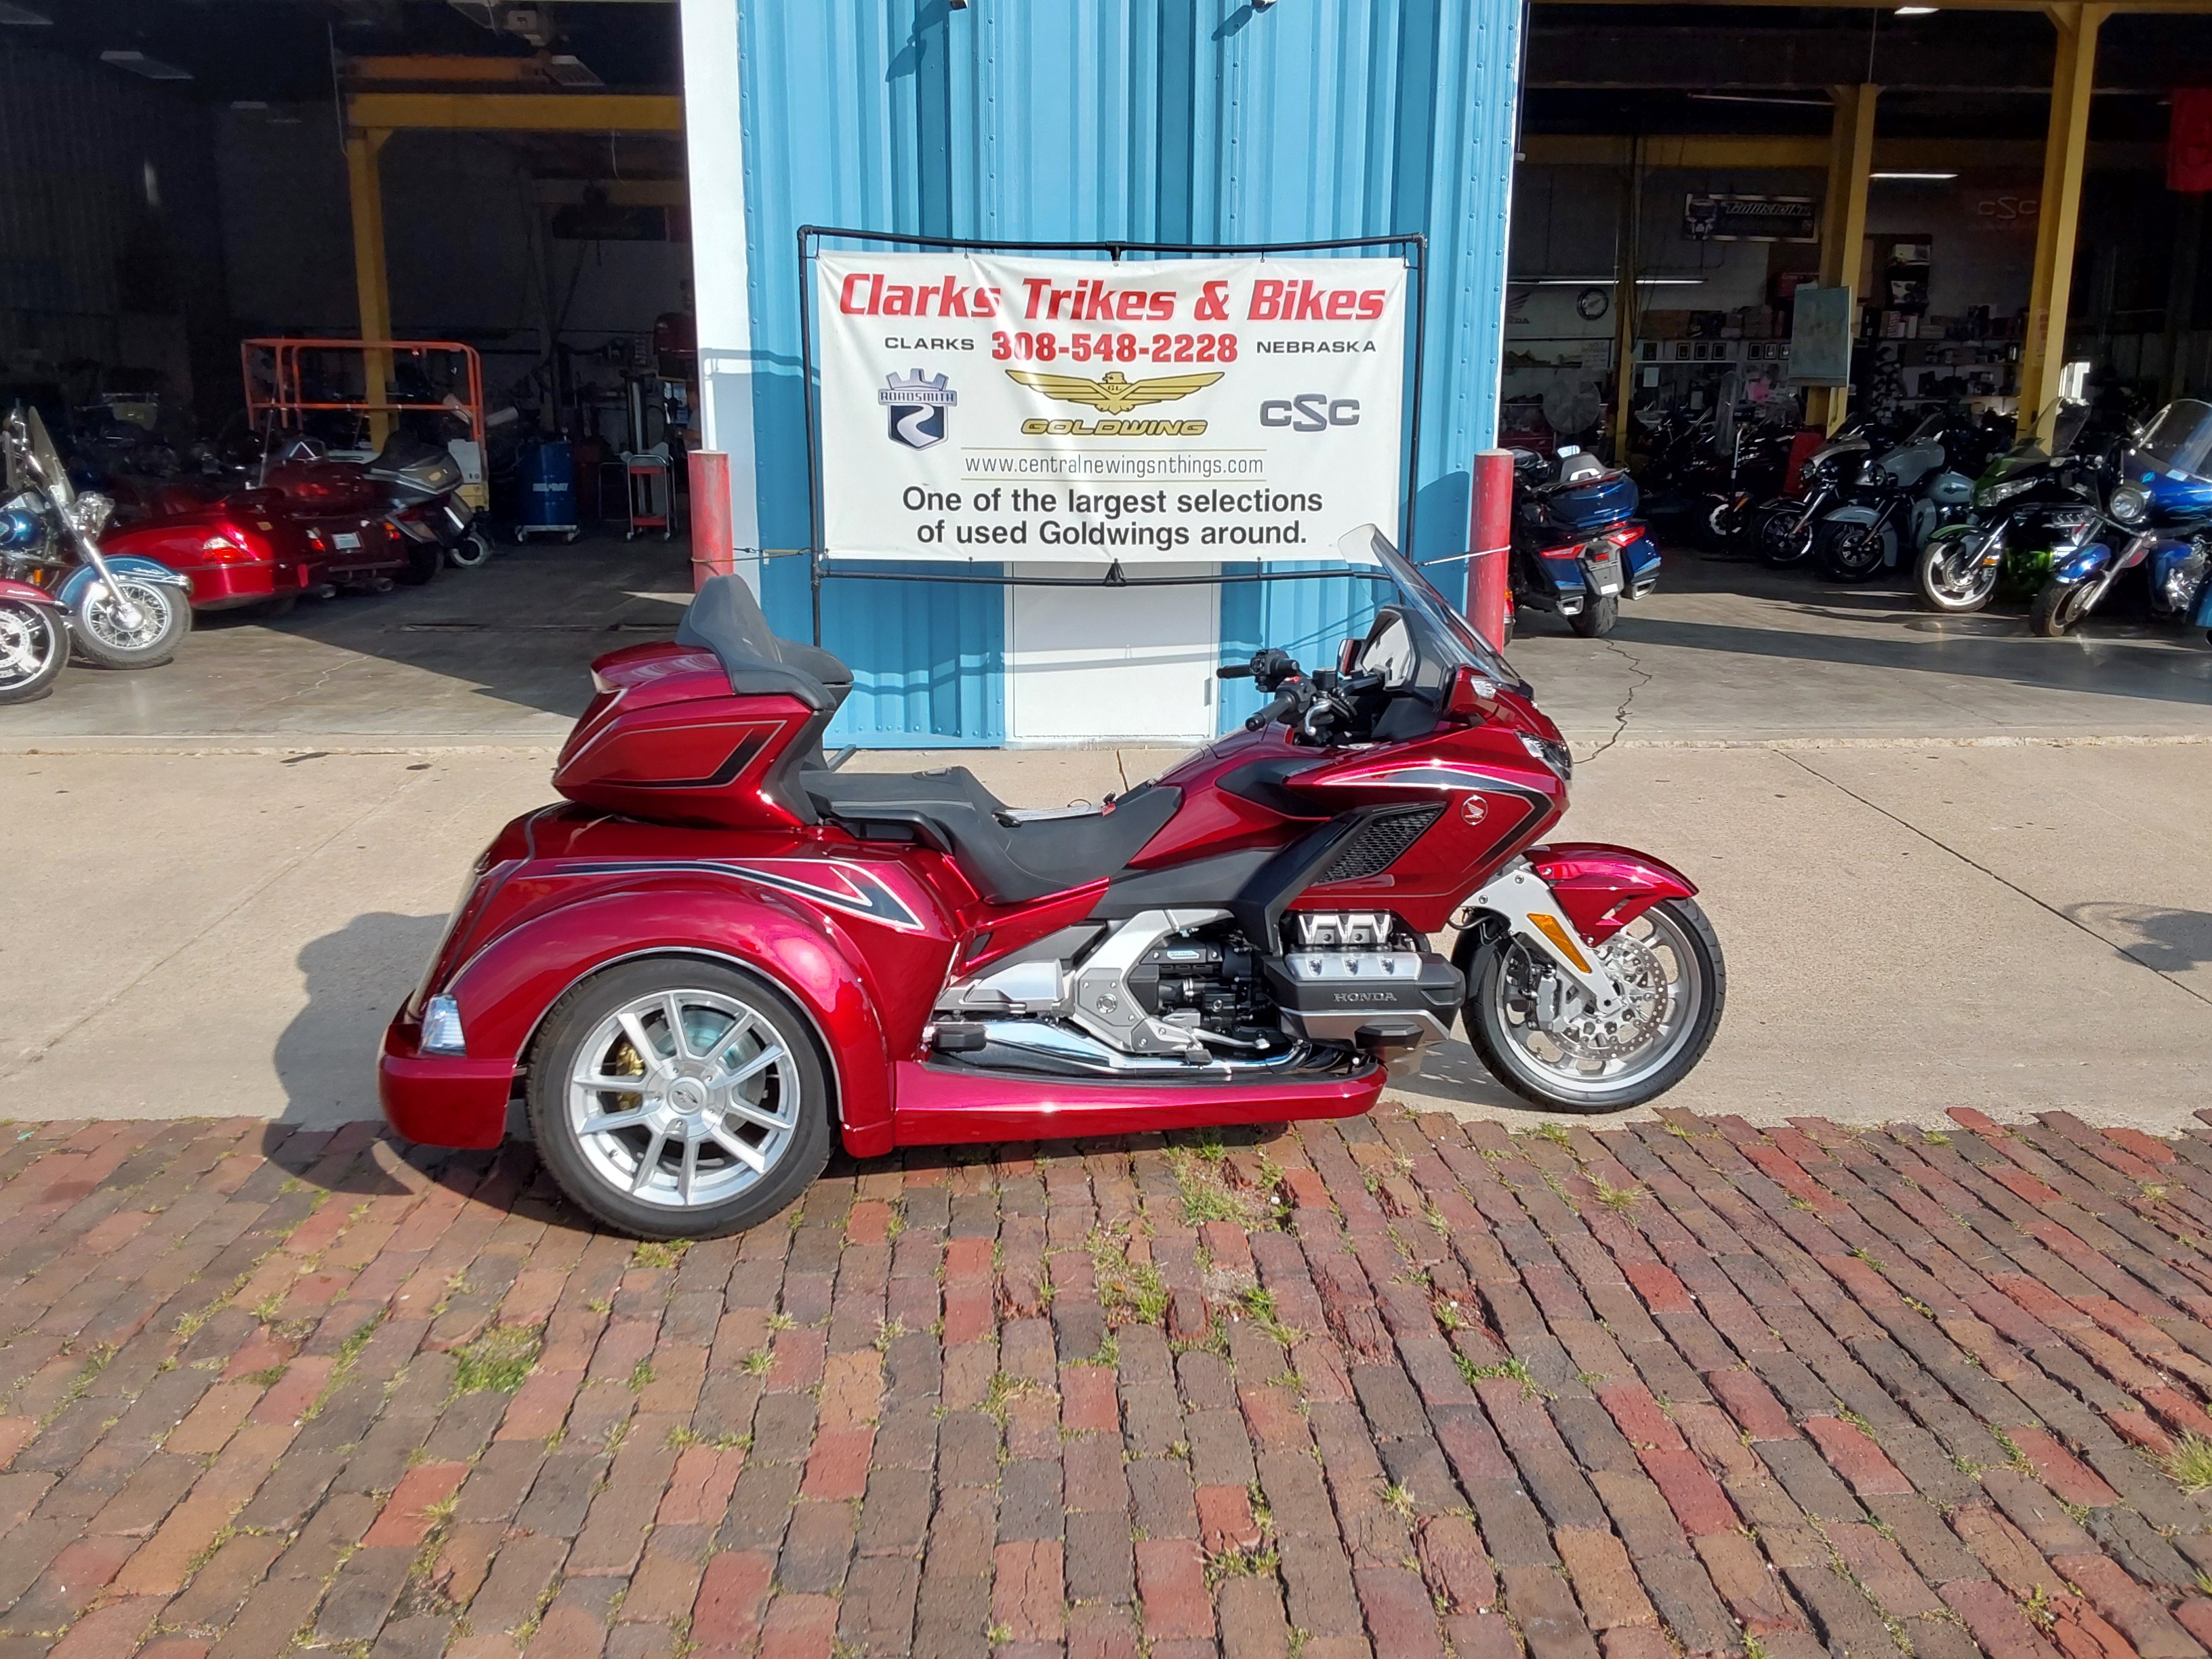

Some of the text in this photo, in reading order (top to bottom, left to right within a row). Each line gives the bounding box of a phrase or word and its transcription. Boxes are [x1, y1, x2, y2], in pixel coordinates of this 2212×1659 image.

[840, 273, 1386, 321] Clarks Trikes & Bikes
[884, 337, 975, 350] CLARKS
[992, 331, 1238, 363] 308-548-2228
[1256, 341, 1376, 353] NEBRASKA
[880, 392, 954, 402] ROADSMITH
[1021, 418, 1208, 436] GOLDWING
[965, 454, 1263, 478] www.centralnewingsnthings.com
[903, 486, 1323, 520] One of the largest selections
[917, 519, 1306, 552] of used Goldwings around.
[1333, 992, 1398, 1002] HONDA
